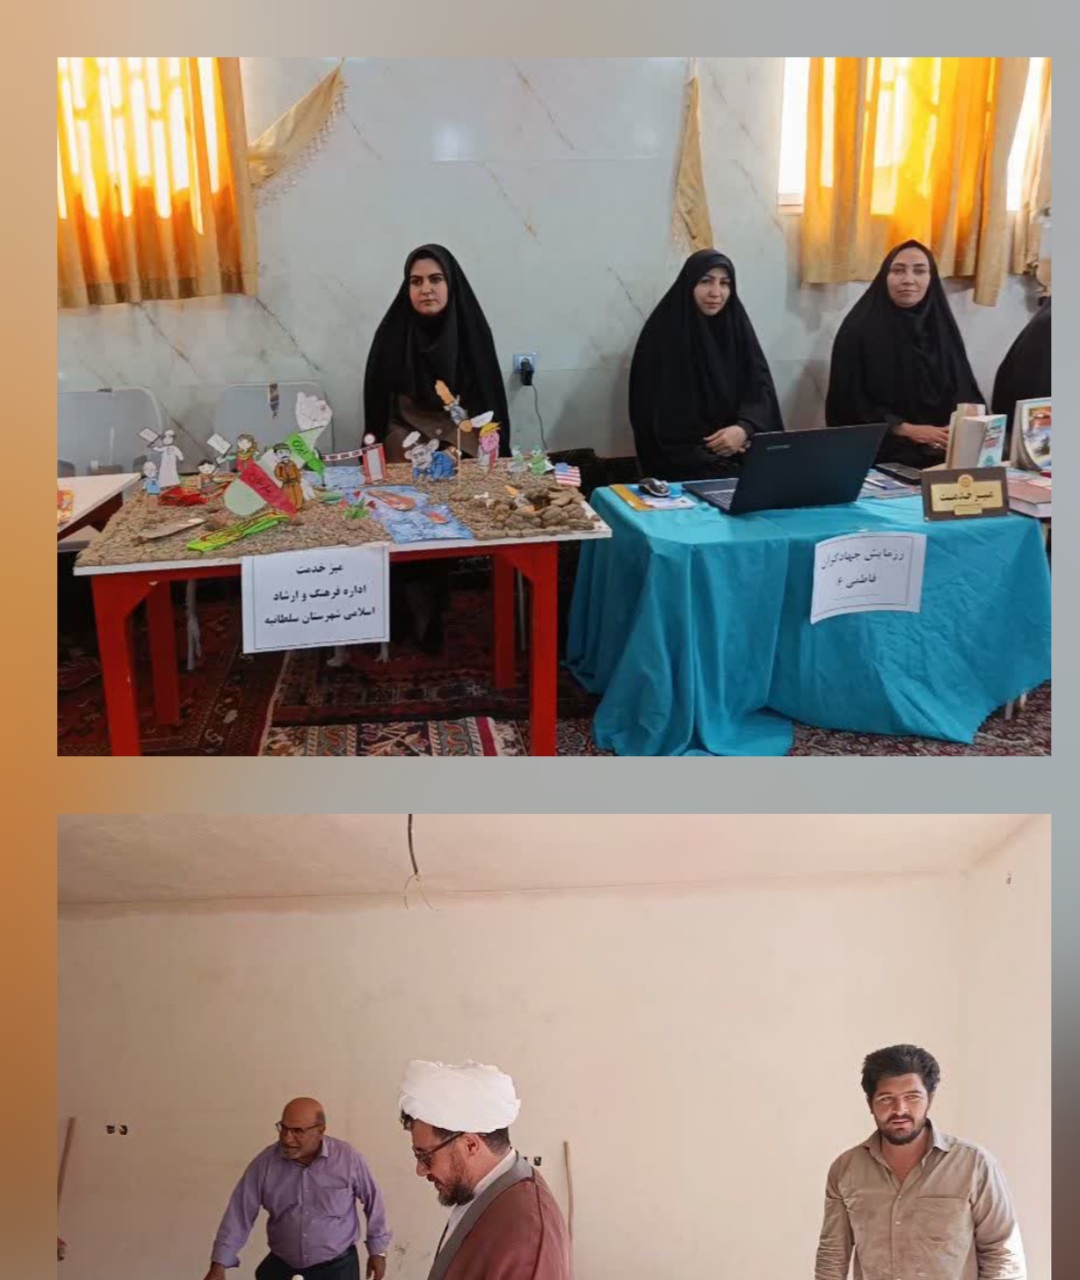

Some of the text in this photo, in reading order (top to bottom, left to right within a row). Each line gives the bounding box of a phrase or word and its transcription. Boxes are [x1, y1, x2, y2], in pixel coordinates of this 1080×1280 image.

[864, 549, 904, 562] رزمایش
[296, 564, 343, 575] میز خدمت
[846, 573, 877, 589] فاطمی
[273, 590, 299, 603] ارشاد
[309, 587, 341, 599] فرهنگ
[343, 585, 367, 598] اداره
[264, 606, 375, 627] اسلامی شهرستان سلطانیه
